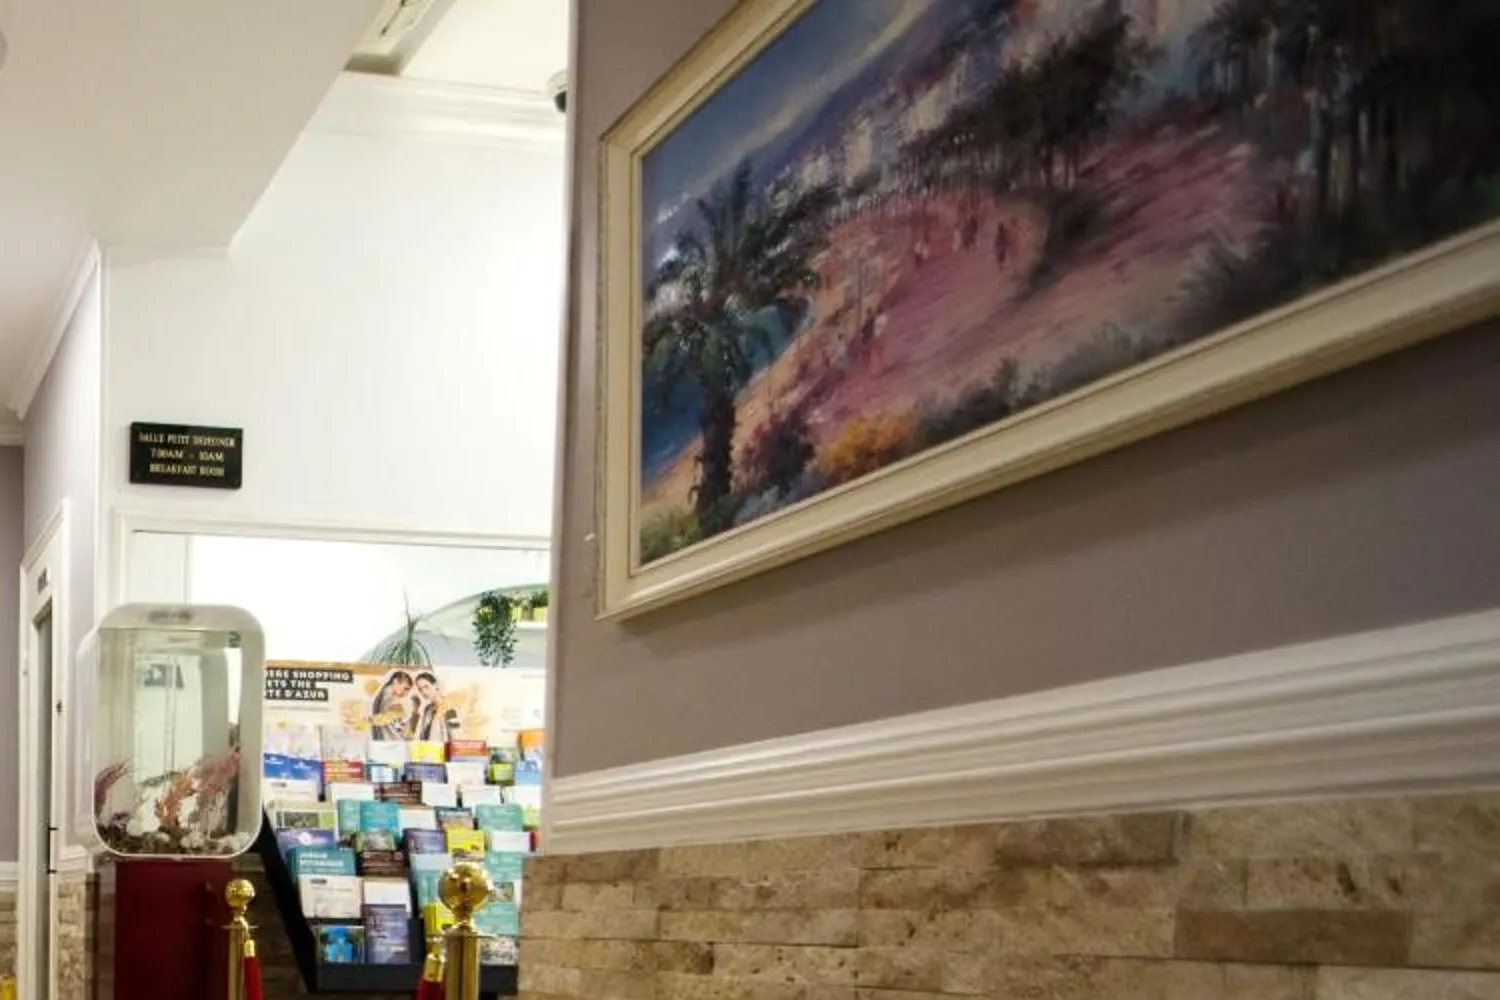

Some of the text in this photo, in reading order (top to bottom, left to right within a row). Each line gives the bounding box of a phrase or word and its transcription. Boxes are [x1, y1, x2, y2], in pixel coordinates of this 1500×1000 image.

[167, 433, 190, 445] PETIT
[149, 463, 197, 475] BREAKFAST
[292, 671, 350, 680] SHOPPING
[291, 680, 312, 688] THE
[284, 690, 325, 699] D'AZUR
